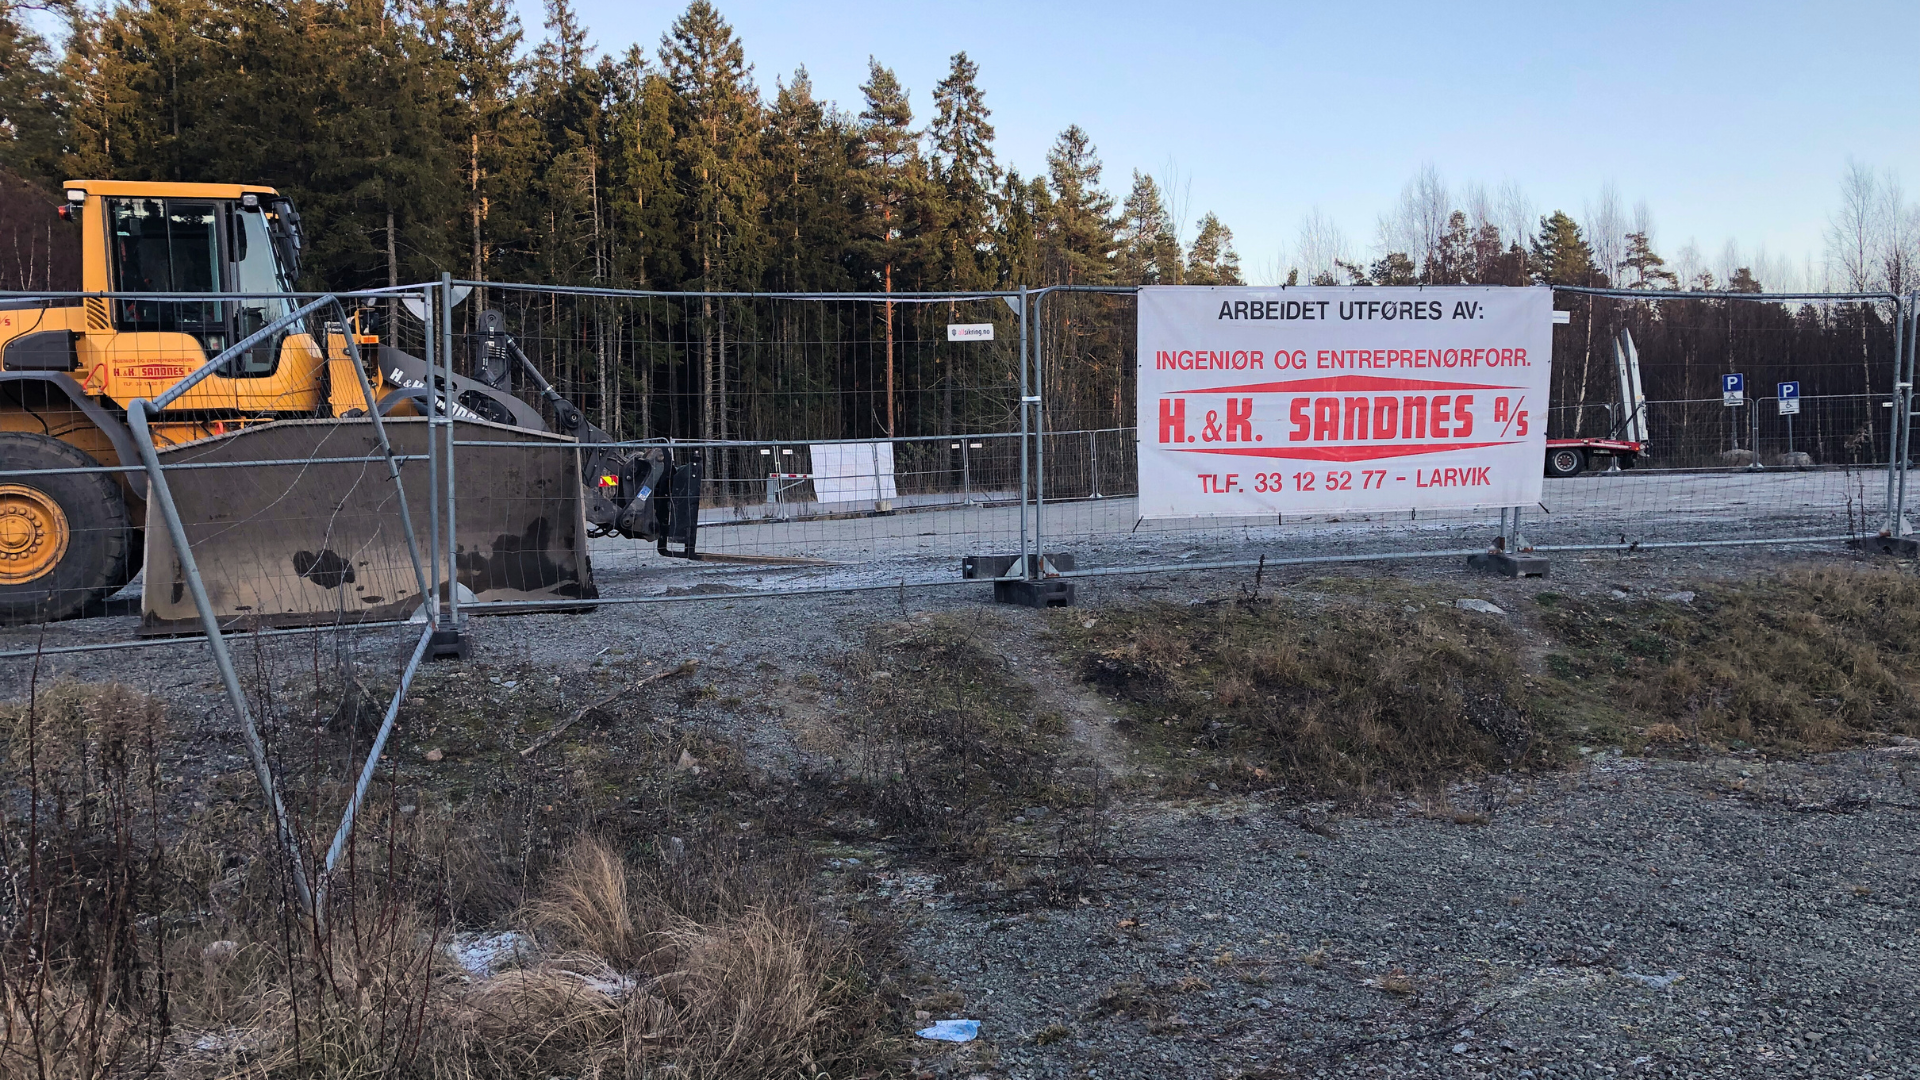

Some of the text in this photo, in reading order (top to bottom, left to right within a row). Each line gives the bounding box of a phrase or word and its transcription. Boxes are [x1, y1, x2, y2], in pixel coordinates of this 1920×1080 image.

[1218, 300, 1484, 321] ARBEIDET UTFØRES AV:
[1156, 348, 1531, 371] INGENIØR OG ENTREPRENØRFORR.
[142, 367, 184, 376] SANDNES
[1727, 376, 1738, 390] P
[1783, 384, 1794, 398] P
[1289, 395, 1474, 442] SANDNES
[1494, 395, 1529, 438] A/S
[1198, 474, 1244, 494] TLF.
[1254, 472, 1283, 493] 33
[1292, 471, 1316, 492] 12
[1325, 470, 1352, 491] 52
[1361, 469, 1387, 490] 77
[1416, 466, 1491, 488] LARVIK
